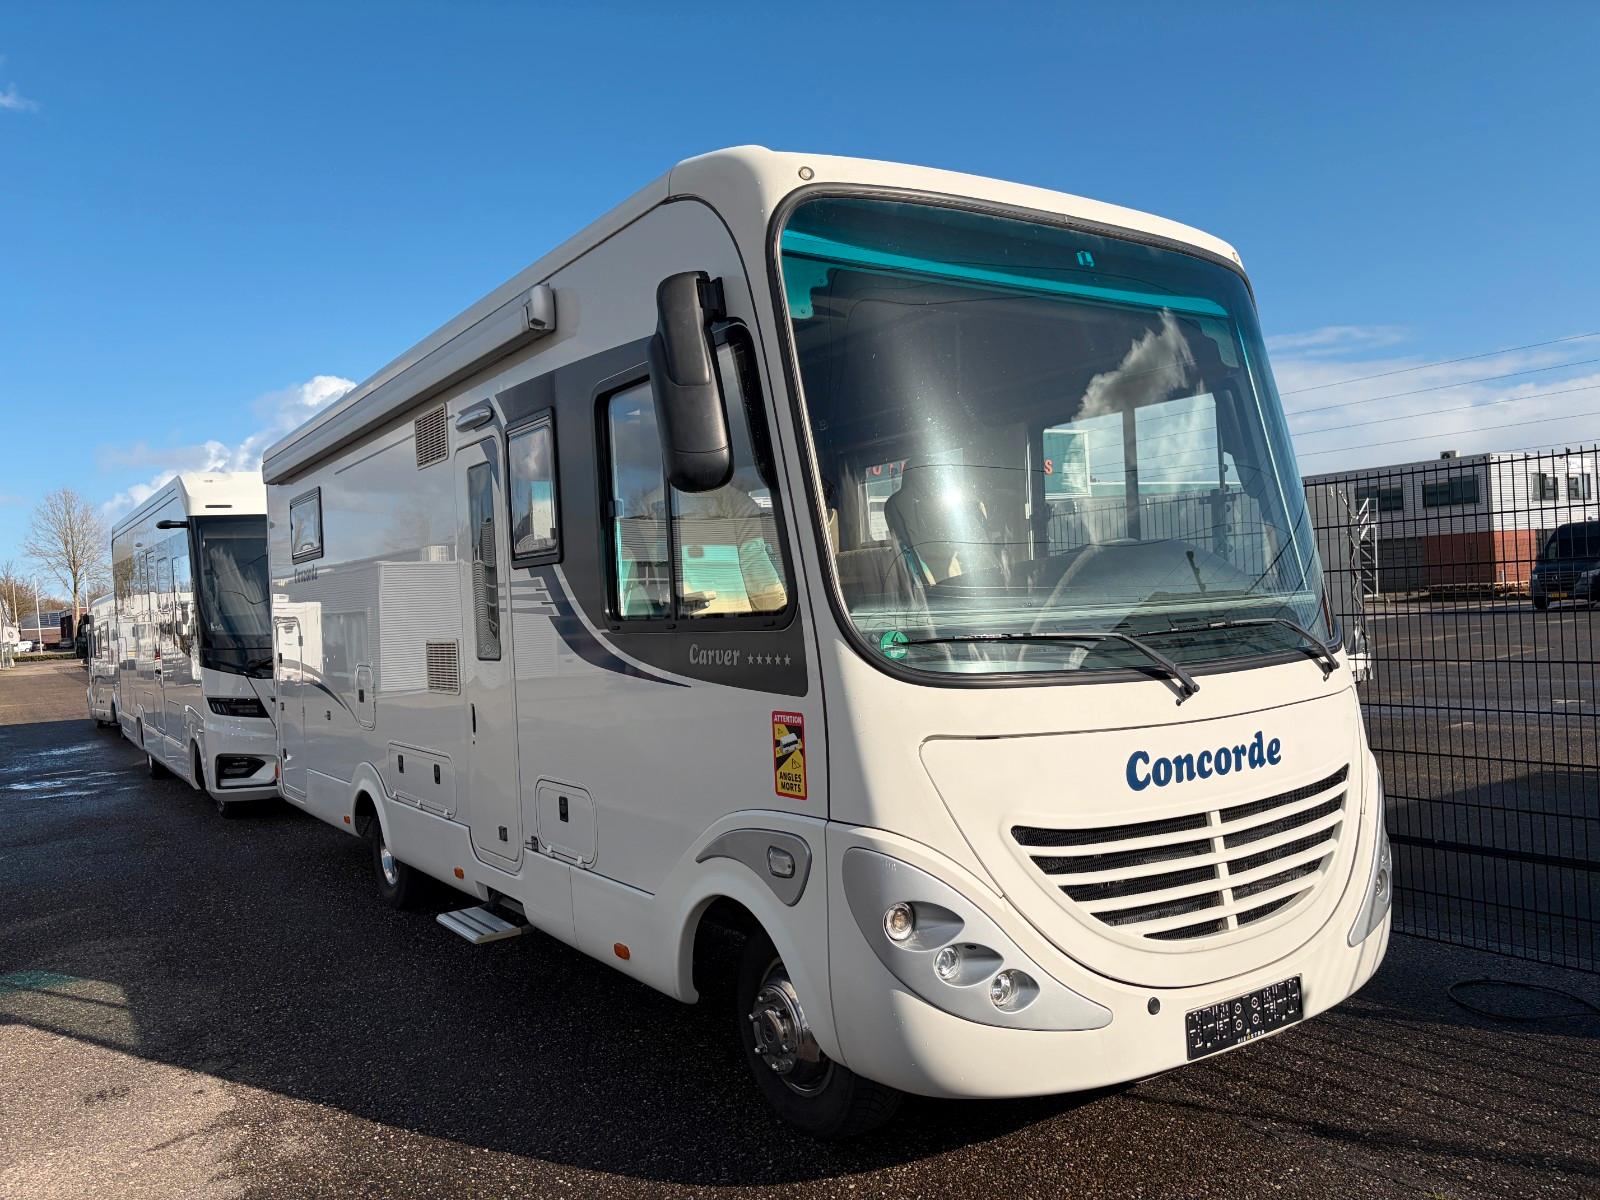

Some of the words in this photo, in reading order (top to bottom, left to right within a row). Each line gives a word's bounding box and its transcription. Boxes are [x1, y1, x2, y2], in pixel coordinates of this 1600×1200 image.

[689, 643, 740, 666] Carver
[773, 714, 802, 724] ATTENTION
[1126, 730, 1282, 792] Concorde
[779, 771, 802, 783] ANGLES
[780, 781, 802, 793] MORTS
